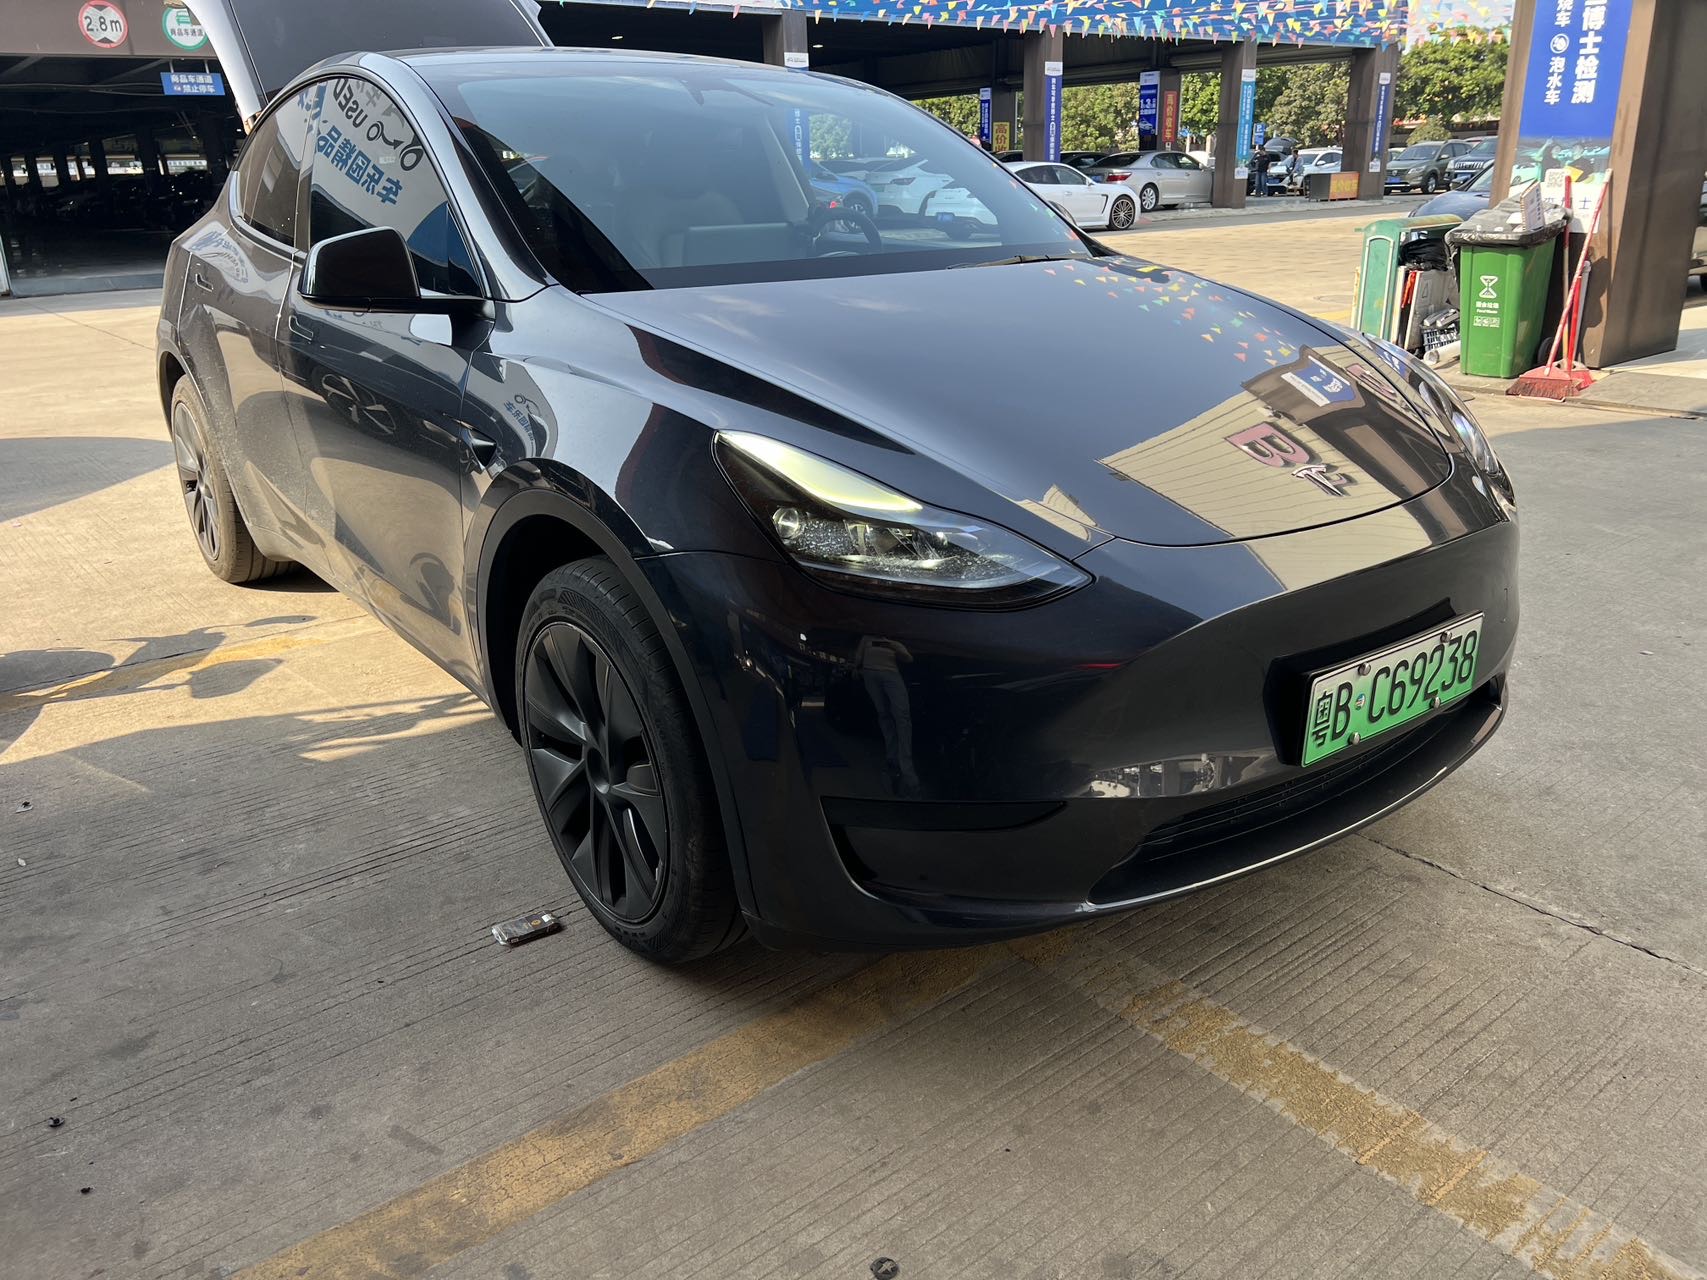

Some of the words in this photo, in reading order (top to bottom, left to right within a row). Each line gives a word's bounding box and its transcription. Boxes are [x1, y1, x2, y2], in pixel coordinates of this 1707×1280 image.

[1544, 56, 1567, 105] 泡水车
[1571, 0, 1608, 104] 博士检测
